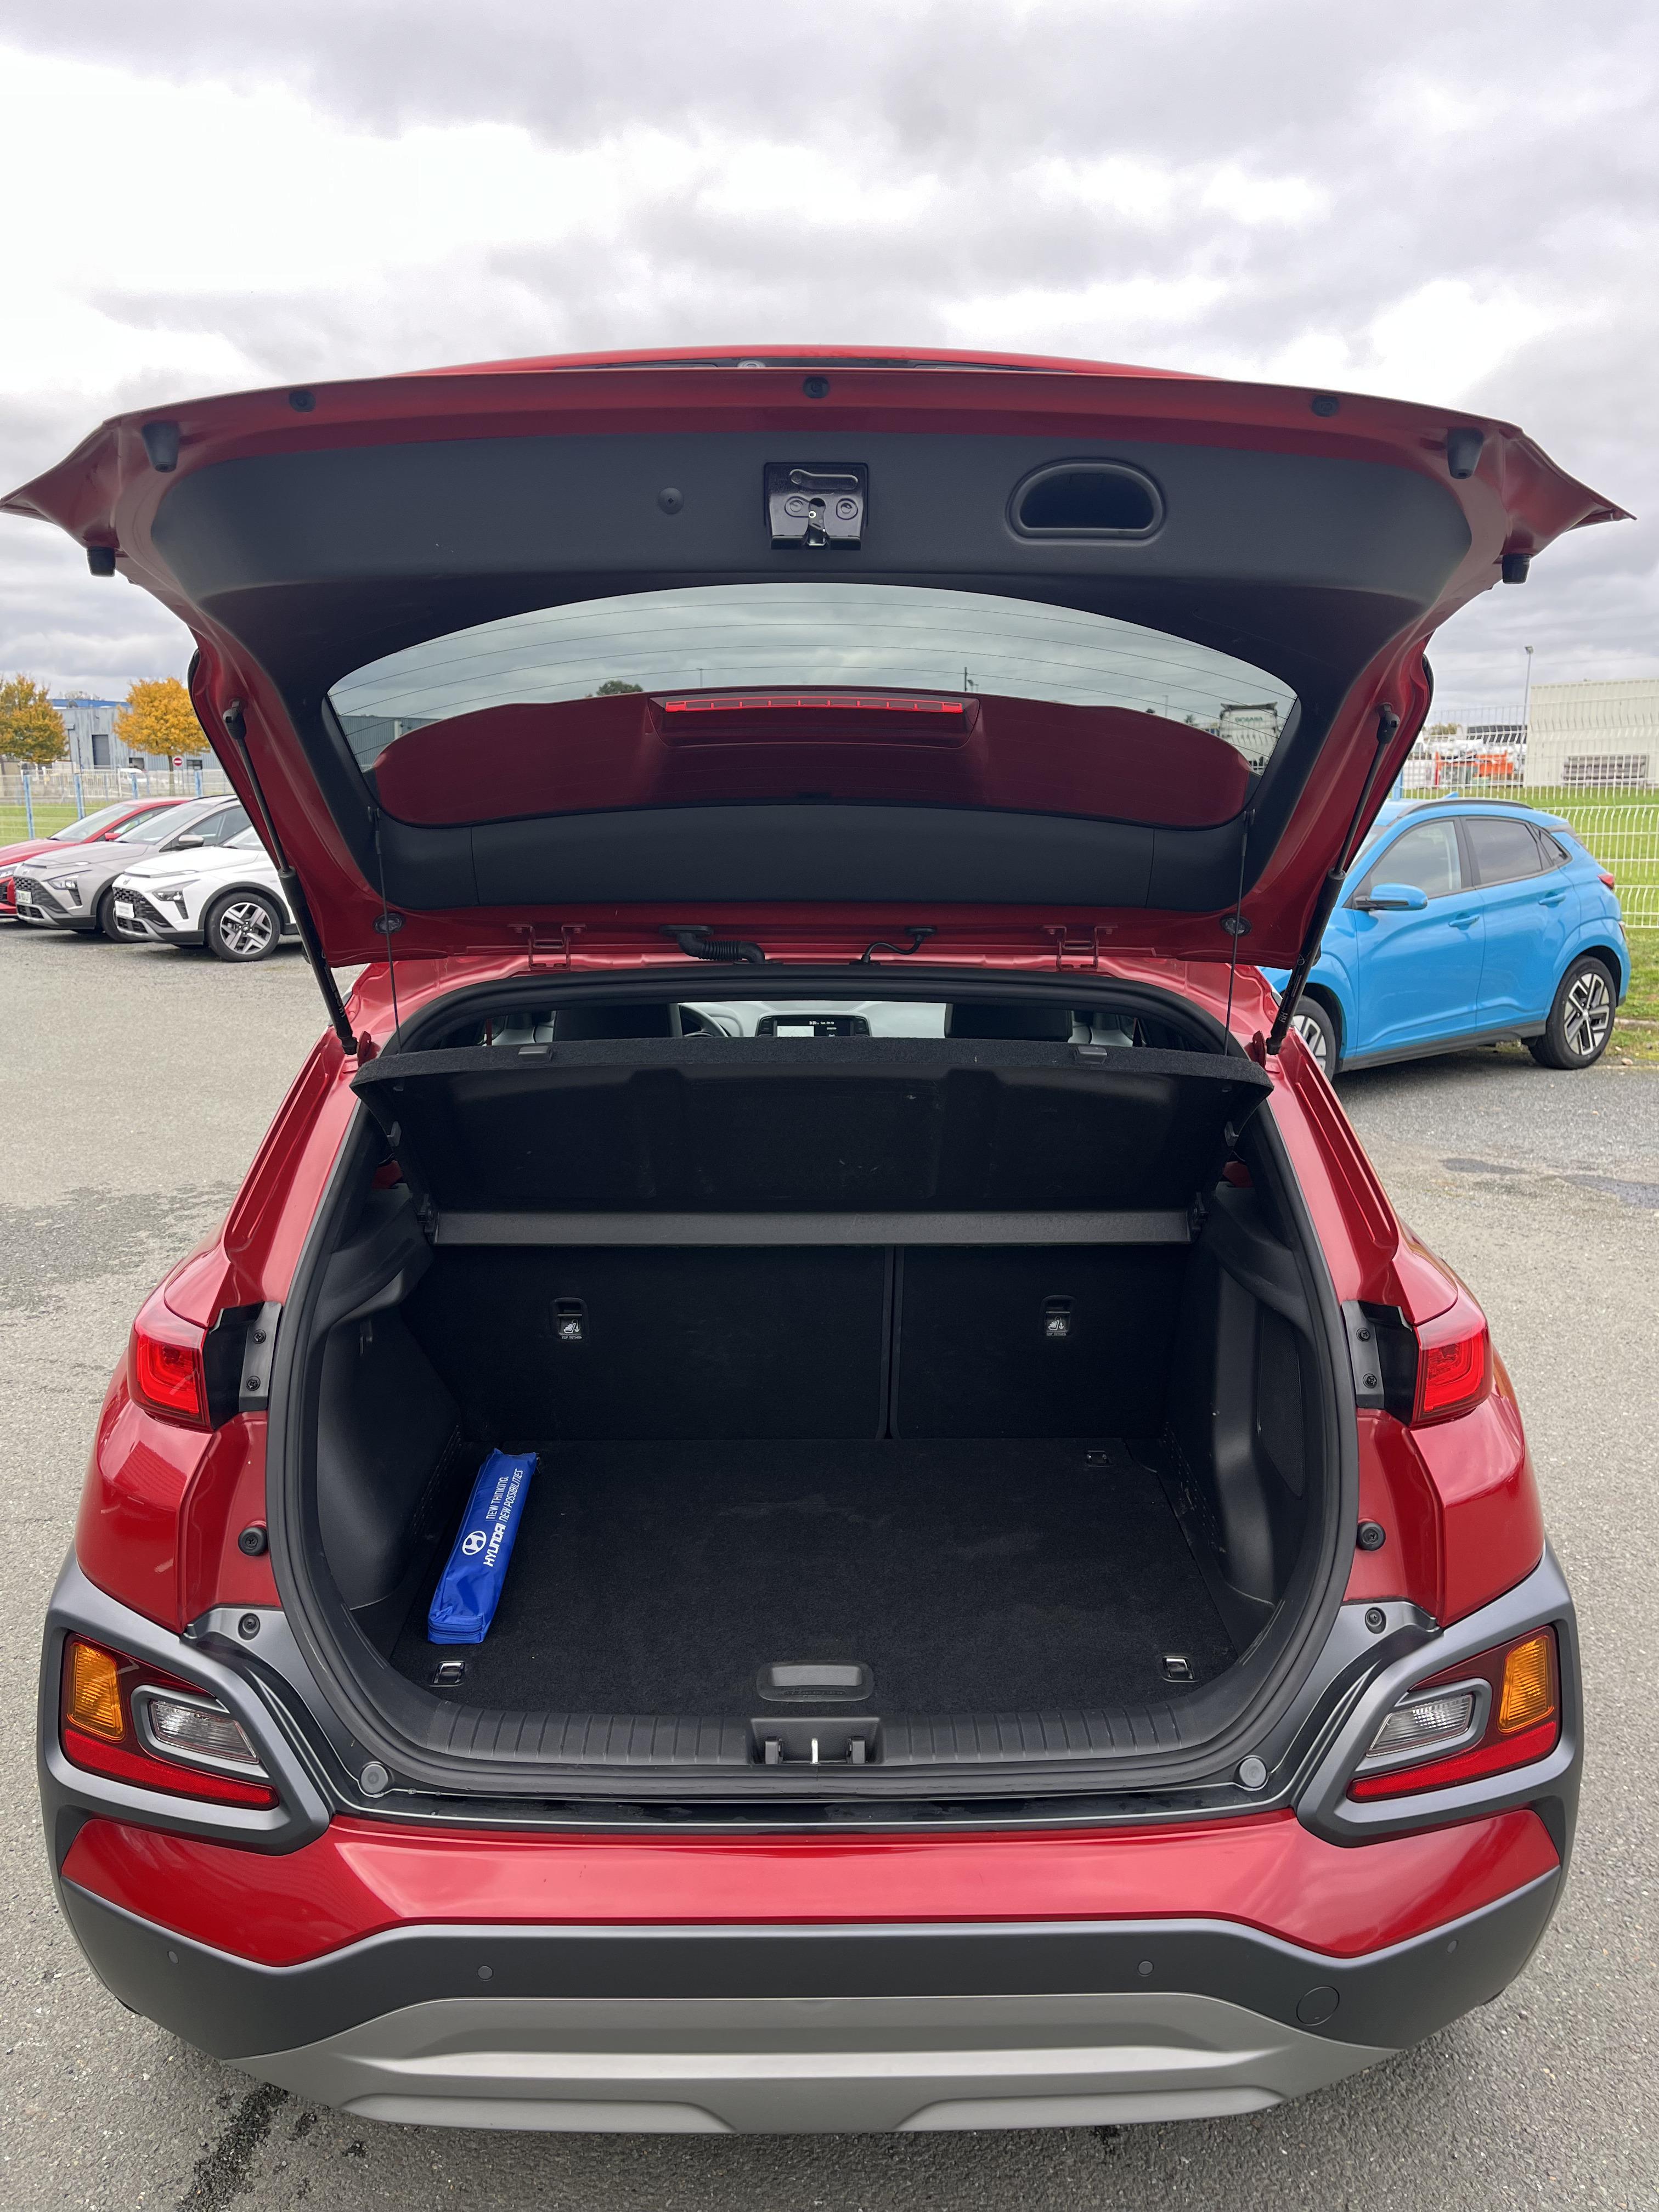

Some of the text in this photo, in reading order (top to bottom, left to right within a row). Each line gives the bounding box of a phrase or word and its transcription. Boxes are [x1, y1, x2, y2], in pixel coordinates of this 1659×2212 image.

[1279, 1012, 1288, 1022] RH
[486, 1504, 499, 1520] NEW
[499, 1506, 511, 1523] NEW
[483, 1522, 506, 1567] HYUNDAI
